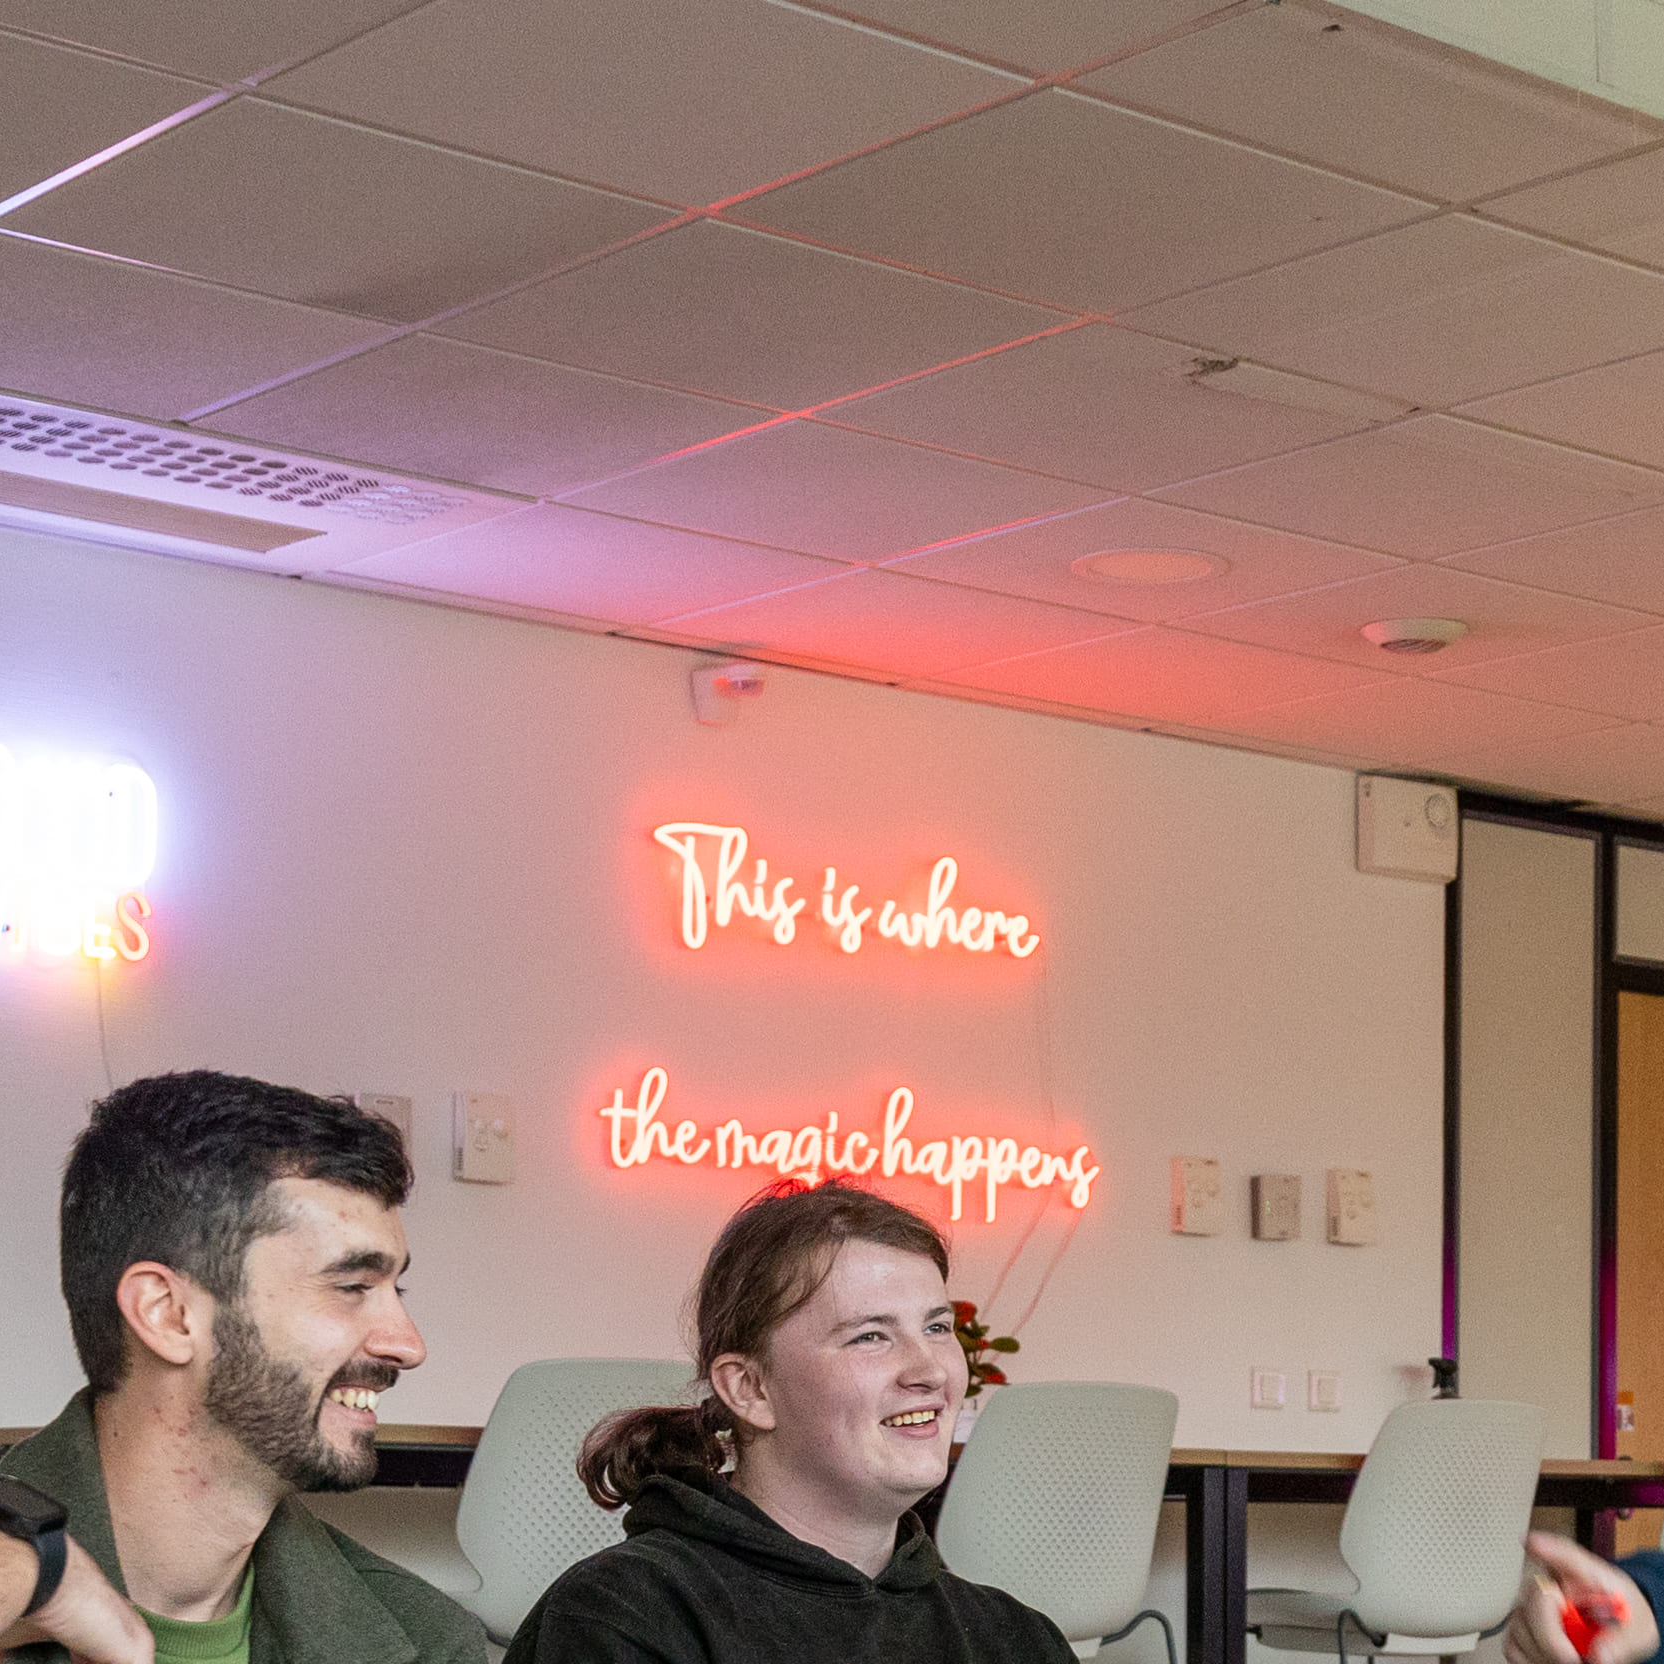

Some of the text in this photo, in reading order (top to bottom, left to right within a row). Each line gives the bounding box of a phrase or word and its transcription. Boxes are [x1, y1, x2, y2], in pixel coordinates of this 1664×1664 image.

[653, 821, 1041, 959] This is where
[599, 1066, 1101, 1223] the magic happens
